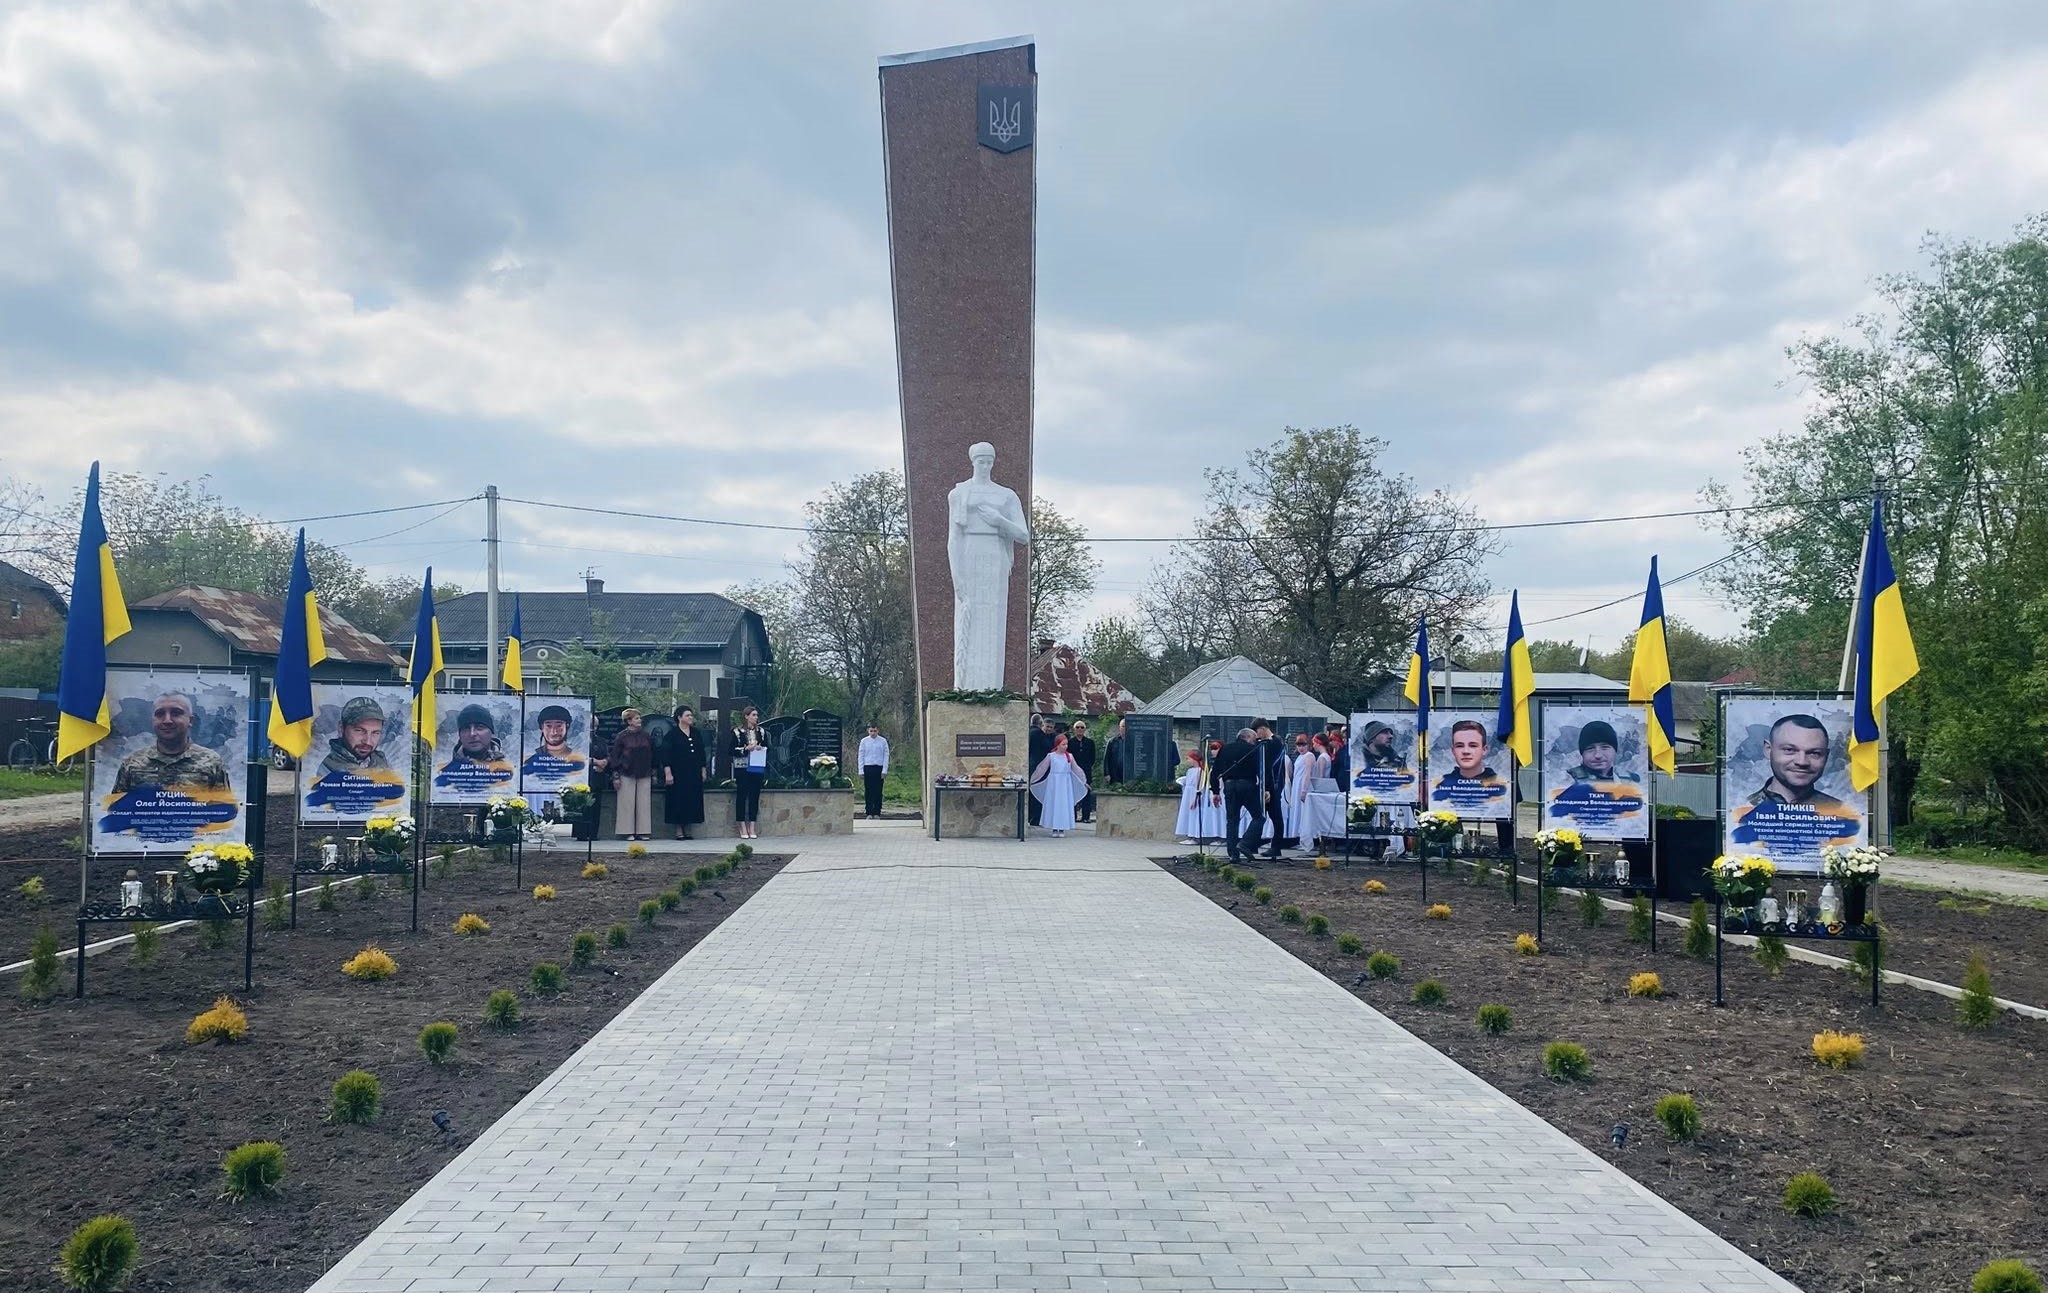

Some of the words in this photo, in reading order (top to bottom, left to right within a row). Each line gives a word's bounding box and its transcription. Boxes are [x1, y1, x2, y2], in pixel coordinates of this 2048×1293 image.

[156, 791, 187, 799] КУЦИК
[135, 800, 156, 808] Олег
[158, 799, 207, 807] Йосипович
[1777, 803, 1816, 812] ТИМКІВ
[1756, 812, 1776, 820] Іван
[1778, 812, 1837, 821] Васильович
[1747, 820, 1784, 828] Молодший
